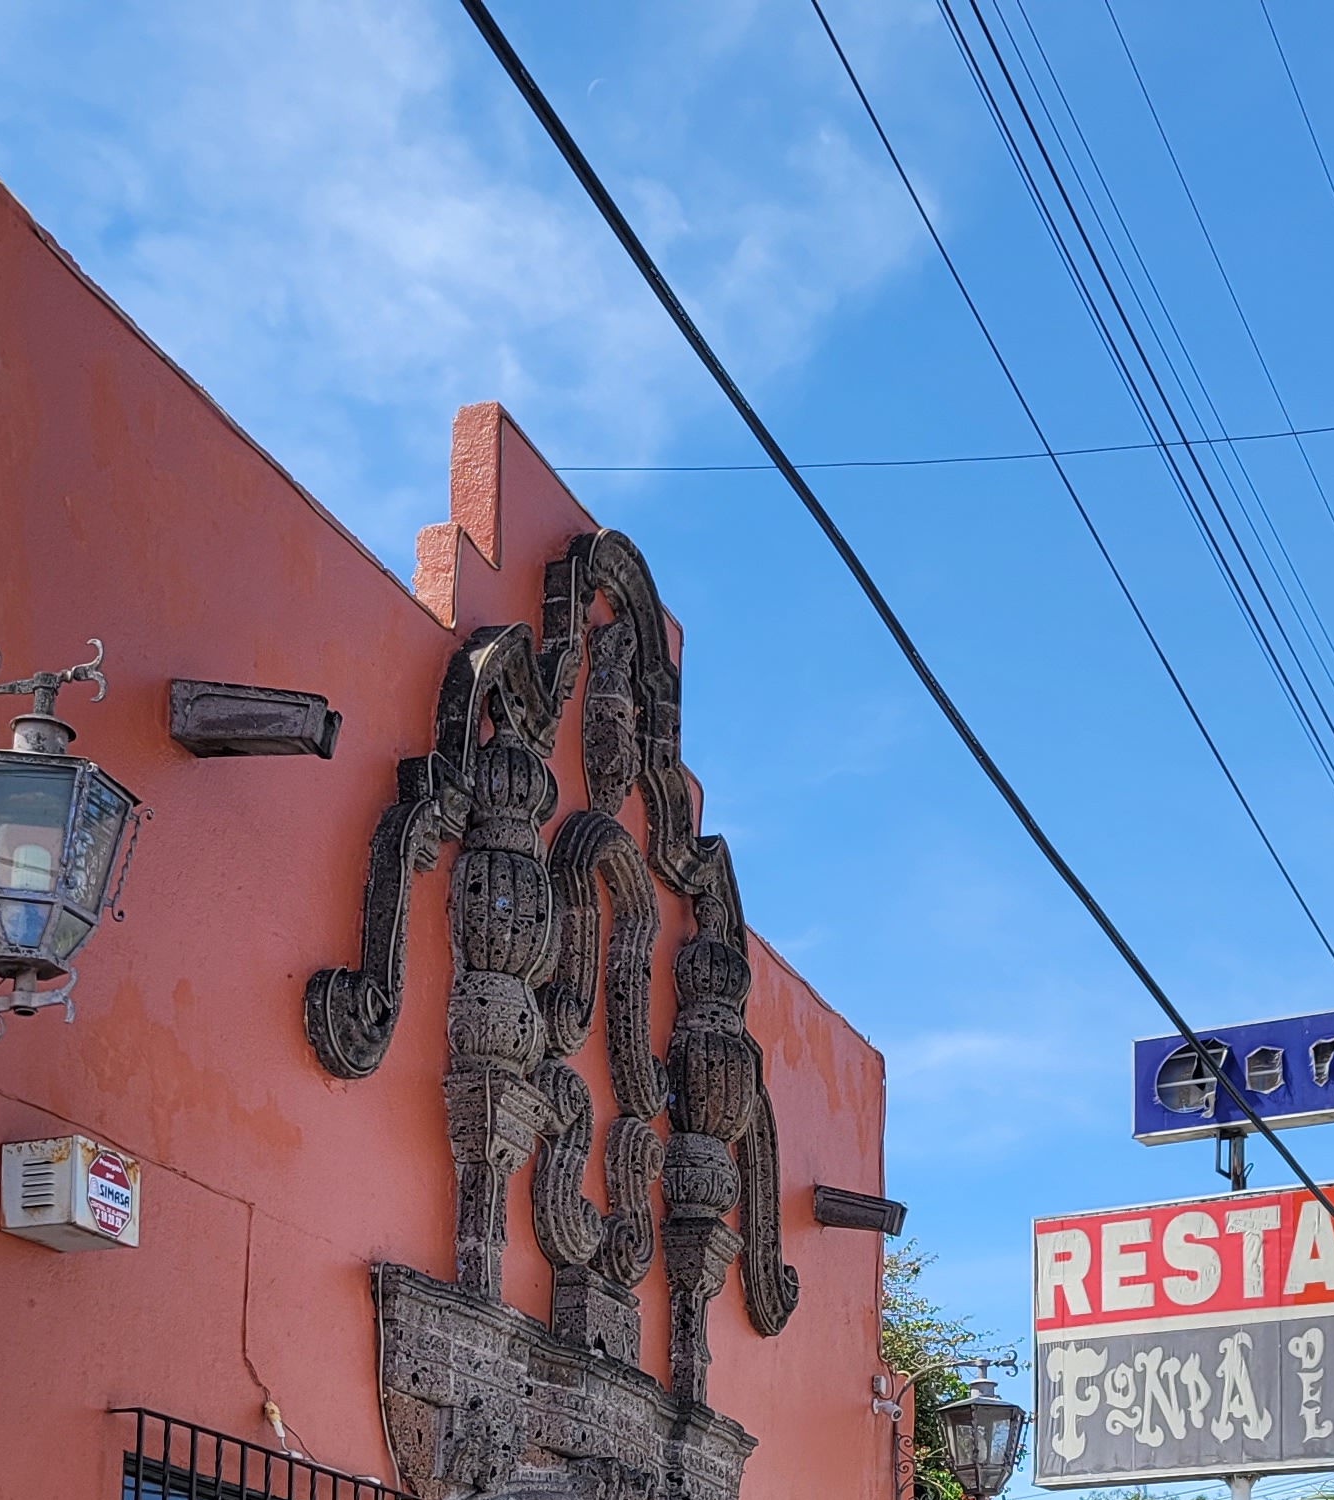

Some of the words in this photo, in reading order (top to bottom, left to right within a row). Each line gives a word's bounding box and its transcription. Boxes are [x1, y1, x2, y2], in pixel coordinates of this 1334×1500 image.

[100, 1184, 130, 1209] SIMASA
[1046, 1331, 1273, 1463] FONDA
[1288, 1328, 1334, 1443] DEL
